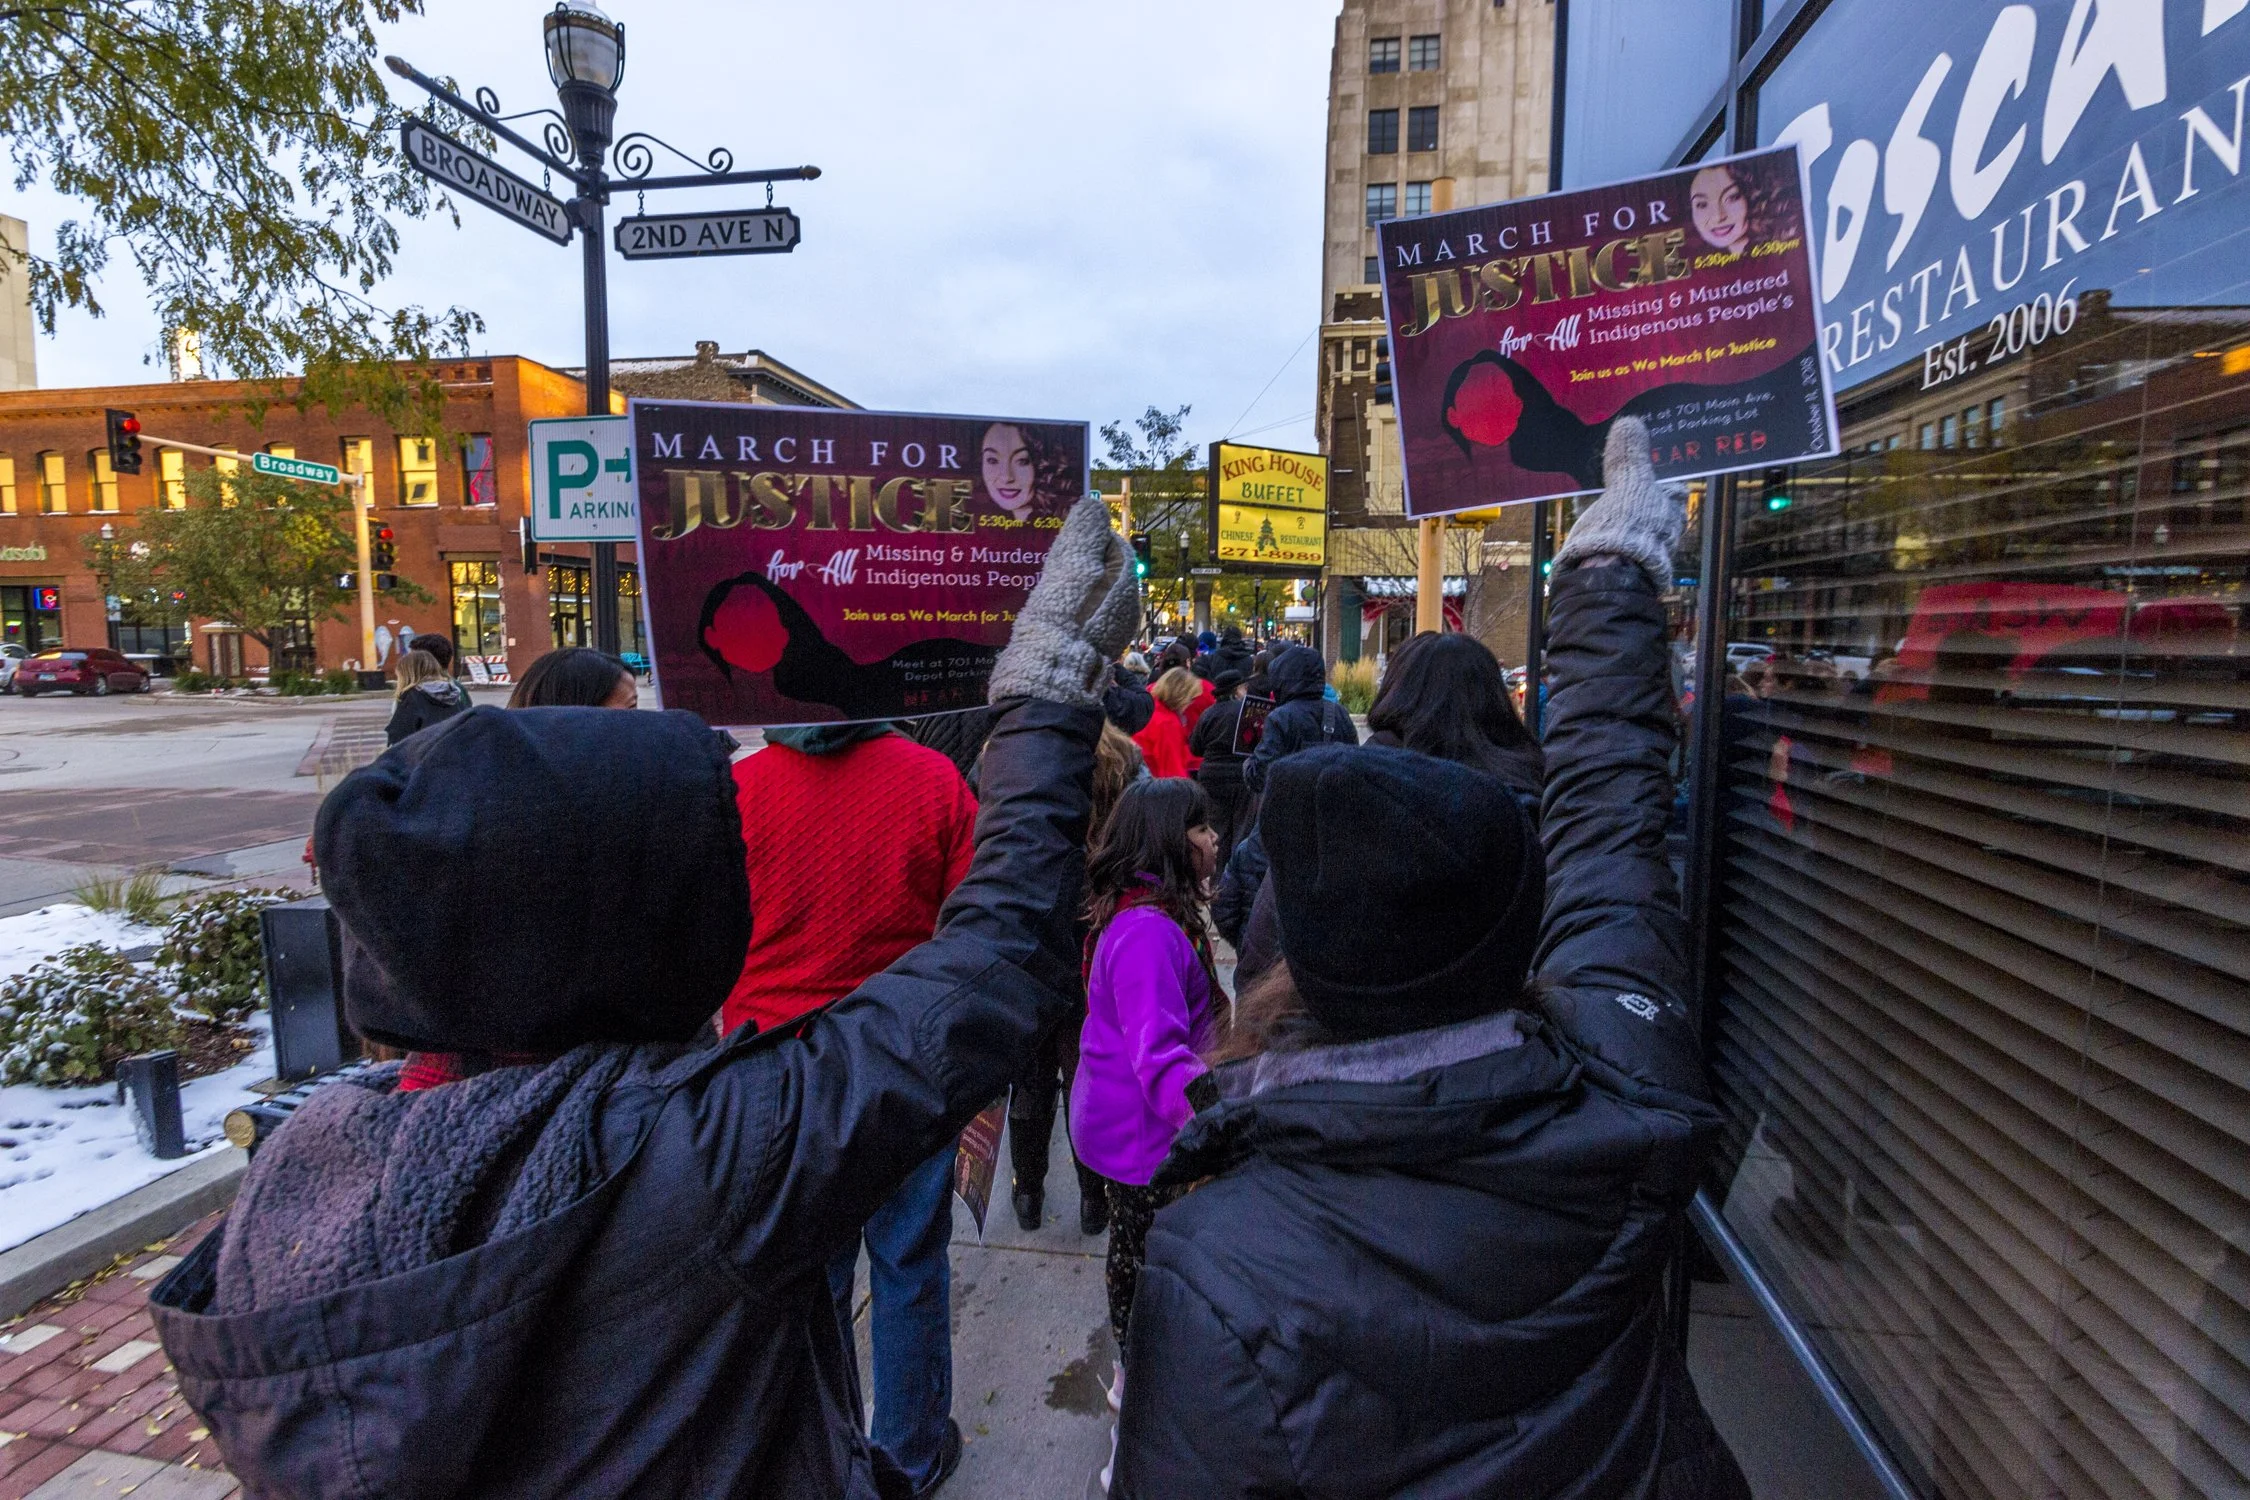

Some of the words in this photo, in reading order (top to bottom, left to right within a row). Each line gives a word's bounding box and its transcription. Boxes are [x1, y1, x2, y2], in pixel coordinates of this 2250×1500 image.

[421, 134, 557, 230] BROADWAY
[631, 224, 687, 250] 2ND
[697, 220, 752, 246] AVE
[764, 218, 784, 242] N
[1397, 221, 1552, 267] MARCH
[1584, 200, 1671, 237] FOR
[1822, 75, 2250, 374] RESTAURAN
[1400, 228, 1692, 338] JUSTICE
[1587, 298, 1663, 323] Missing
[1669, 292, 1682, 308] &
[1688, 269, 1790, 305] Murdered
[1500, 325, 1532, 358] for
[1534, 313, 1582, 351] All
[1589, 311, 1702, 344] Indigenous
[1707, 293, 1794, 324] People's
[1920, 336, 1977, 391] Est.
[1985, 276, 2079, 366] 2006
[1569, 367, 1595, 383] Join
[1599, 368, 1612, 379] us
[1615, 364, 1630, 376] as
[1632, 357, 1657, 372] We
[1660, 348, 1702, 368] March
[1706, 344, 1725, 363] for
[1728, 337, 1777, 357] Justice
[1651, 423, 1673, 437] pot
[1678, 413, 1732, 430] Parking
[1735, 407, 1760, 421] Lot
[1657, 408, 1672, 420] at
[1704, 397, 1740, 411] Main
[652, 432, 835, 464] MARCH
[870, 441, 961, 469] FOR
[1650, 441, 1700, 466] EAR
[1716, 429, 1767, 456] RED
[260, 456, 334, 482] Broadway
[1222, 456, 1265, 481] KING
[1269, 454, 1324, 492] HOUSE
[651, 468, 975, 541] JUSTICE
[1241, 482, 1305, 503] BUFFET
[979, 515, 1023, 530] 5:30pm
[1220, 530, 1254, 542] CHINESE
[1281, 535, 1322, 547] RESTAURANT
[0, 541, 48, 561] asabi
[766, 549, 804, 585] for
[807, 548, 859, 586] All
[866, 545, 945, 565] Missing
[950, 547, 963, 562] &
[970, 547, 1049, 563] Murdere
[1221, 547, 1322, 561] 271-8989
[866, 570, 981, 588] Indigenous
[987, 571, 1043, 590] Peopl
[843, 609, 869, 621] Join
[872, 612, 887, 621] us
[891, 612, 906, 621] as
[909, 609, 933, 621] We
[937, 610, 977, 622] March
[981, 610, 999, 624] for
[892, 659, 924, 669] Meet
[974, 657, 994, 665] Ma
[904, 671, 943, 682] Depot
